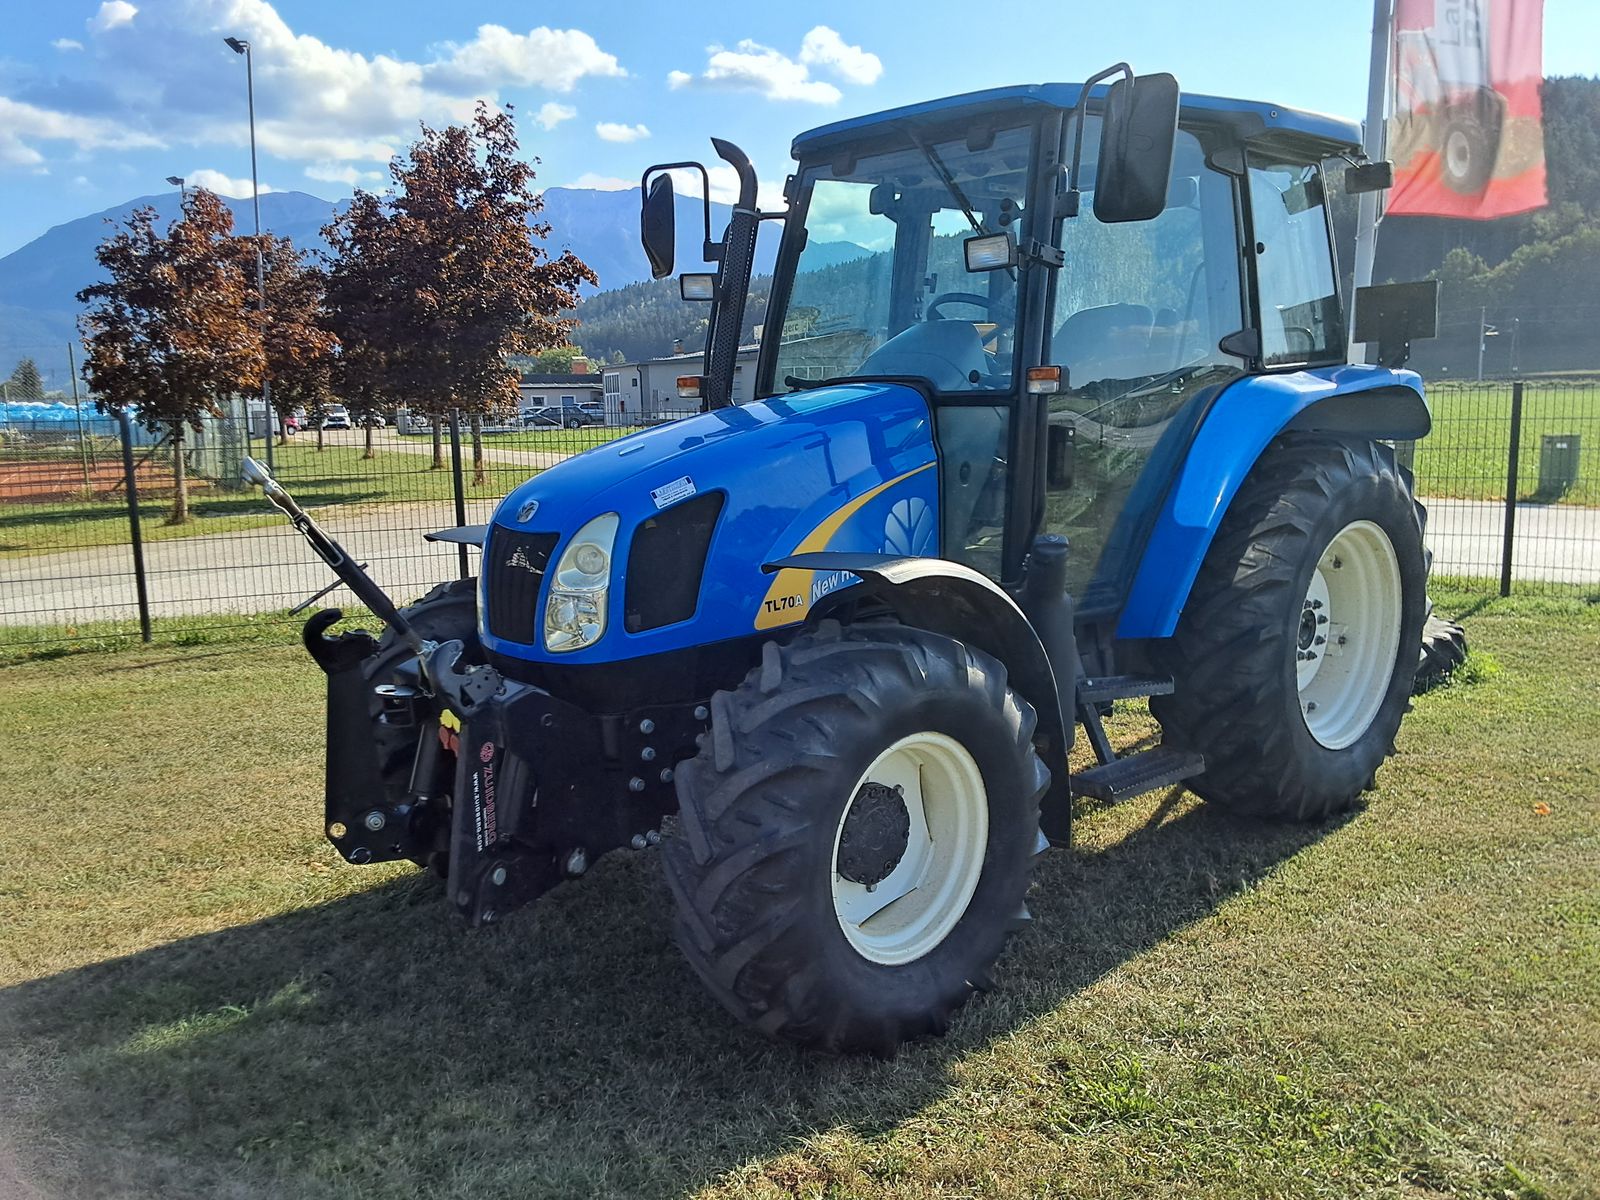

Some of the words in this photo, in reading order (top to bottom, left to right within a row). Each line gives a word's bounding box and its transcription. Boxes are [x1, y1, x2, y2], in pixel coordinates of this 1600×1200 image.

[812, 572, 839, 602] New
[765, 594, 803, 613] TL70A
[483, 763, 497, 845] ZUIDBERG
